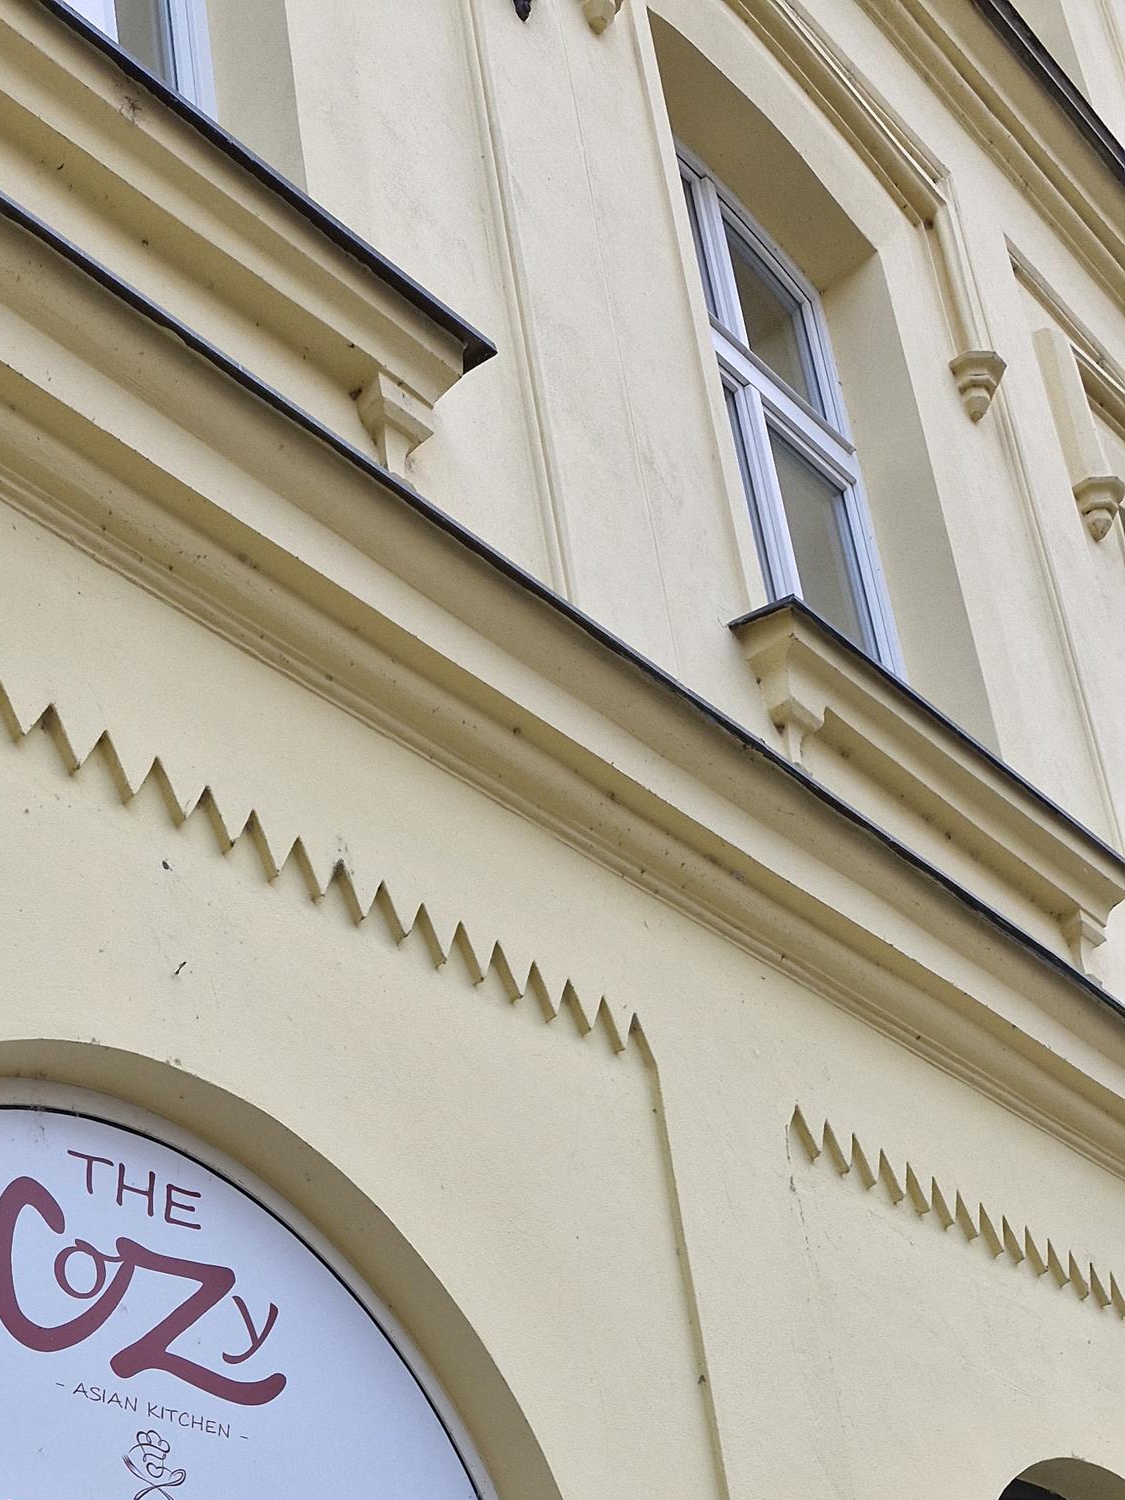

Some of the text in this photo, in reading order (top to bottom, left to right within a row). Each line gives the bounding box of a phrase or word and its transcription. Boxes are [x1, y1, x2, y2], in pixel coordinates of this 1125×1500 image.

[67, 1149, 202, 1231] THE
[73, 1383, 232, 1440] ASIAN KITCHEN
